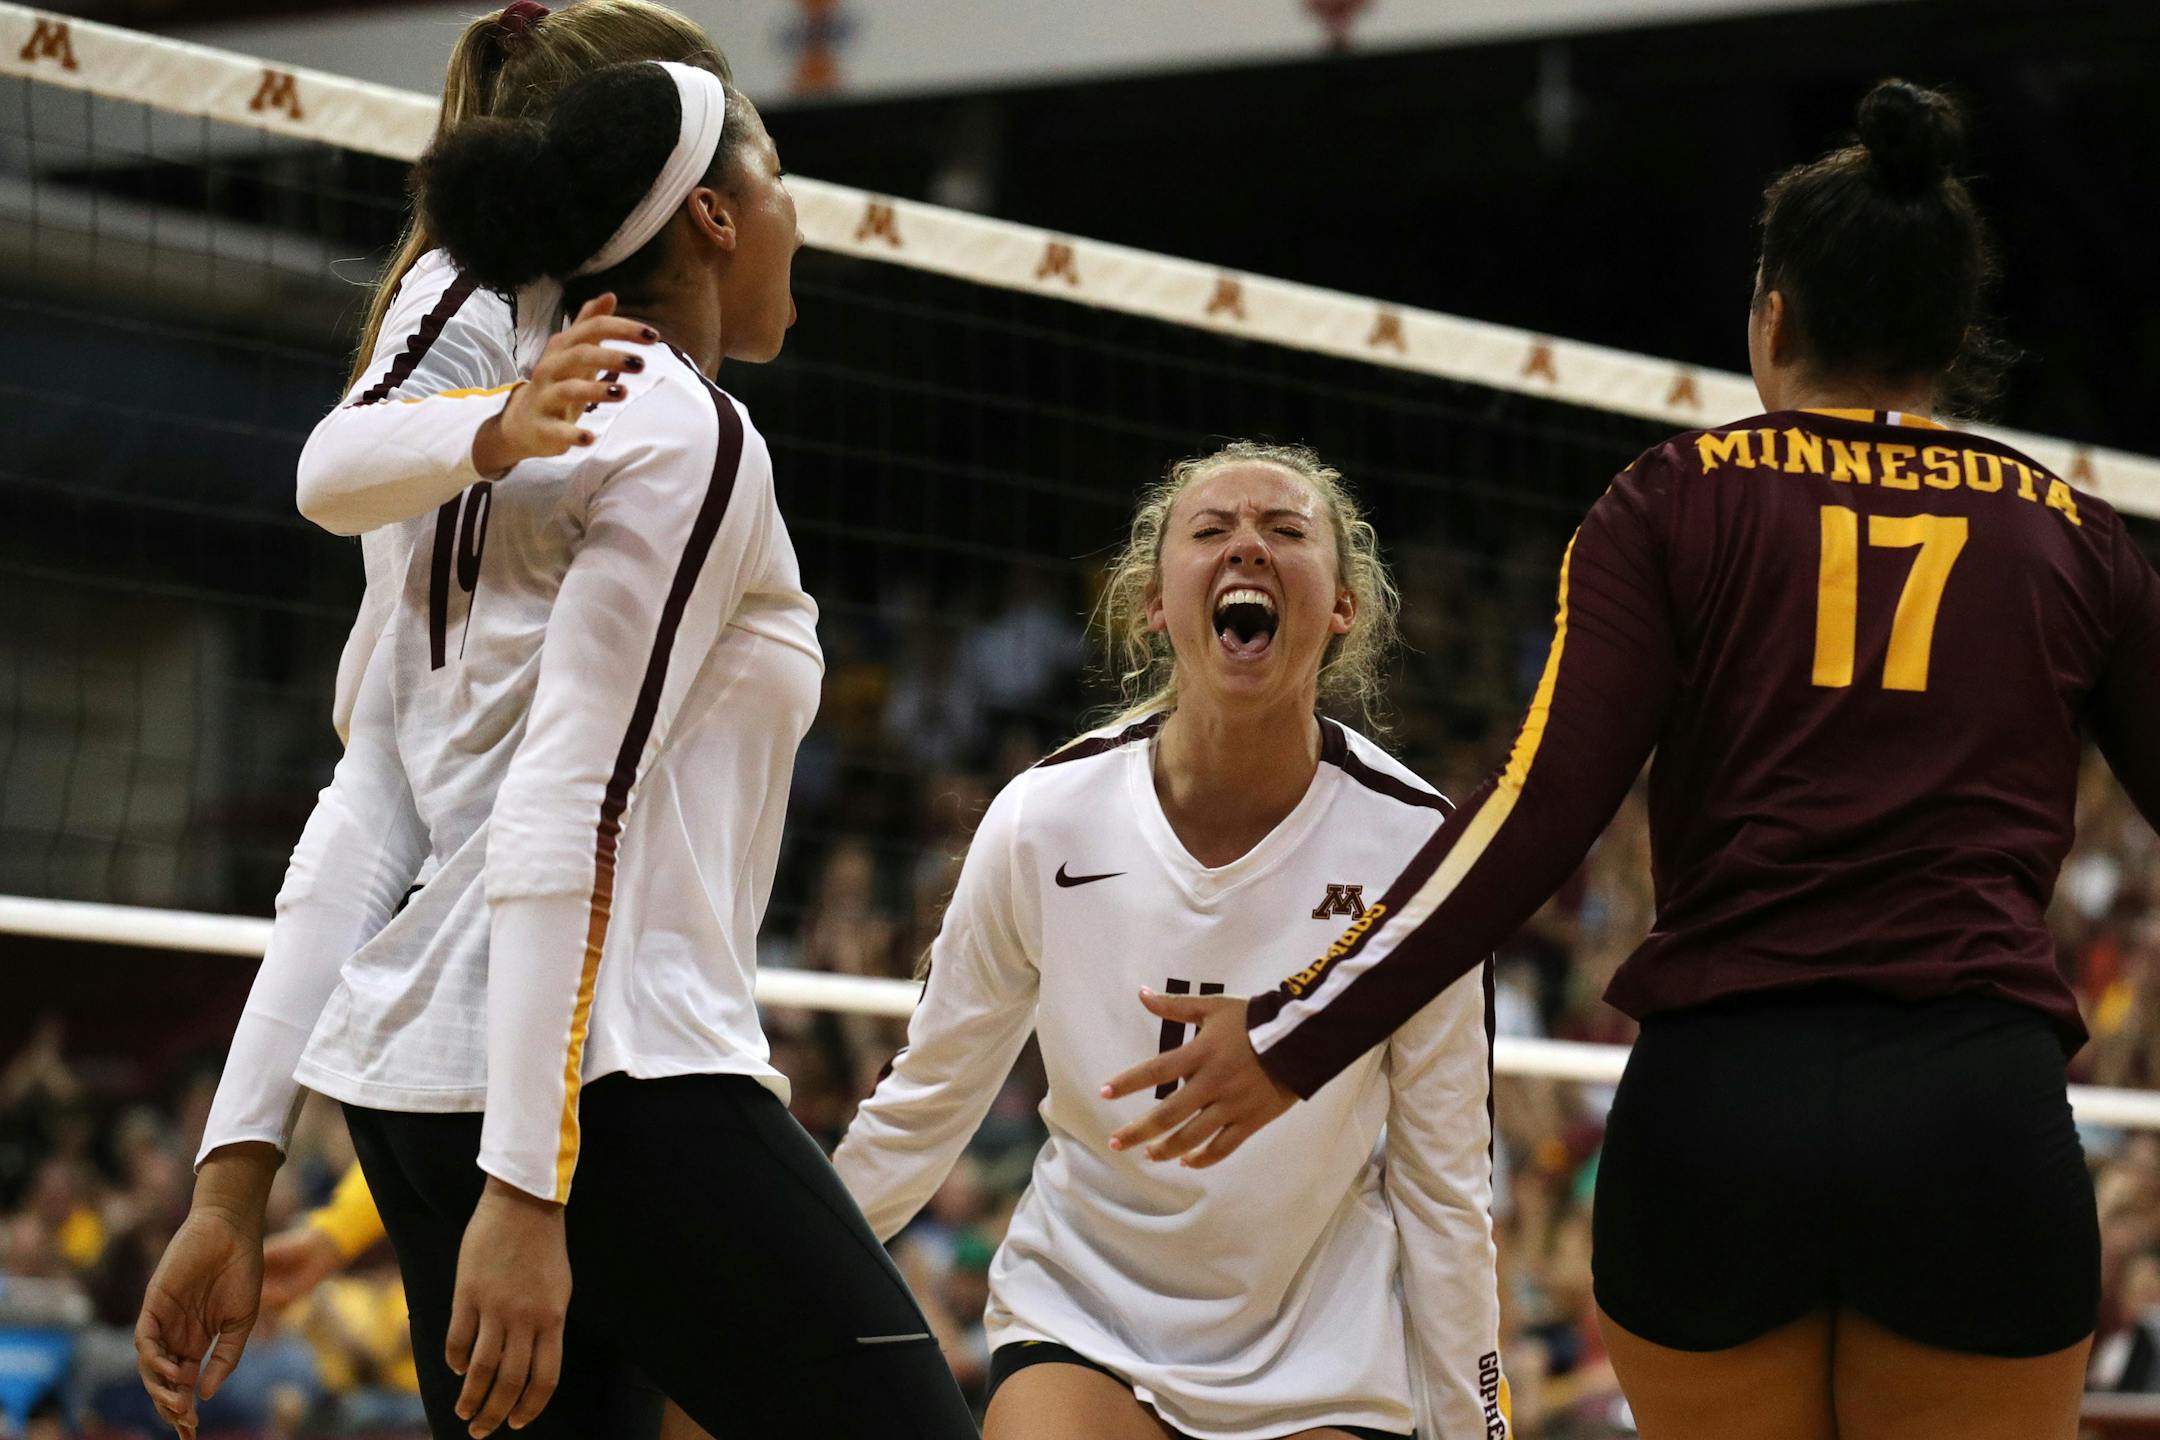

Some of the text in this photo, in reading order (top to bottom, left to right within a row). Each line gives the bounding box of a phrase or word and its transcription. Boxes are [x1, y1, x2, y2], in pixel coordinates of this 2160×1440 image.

[19, 18, 78, 71] M
[249, 69, 303, 119] M
[855, 203, 903, 248] M
[1695, 427, 2082, 526] MINNESOTA
[429, 480, 492, 672] 19
[1812, 505, 1968, 692] 17
[1312, 884, 1367, 920] M
[1479, 1350, 1506, 1440] GOPHE
